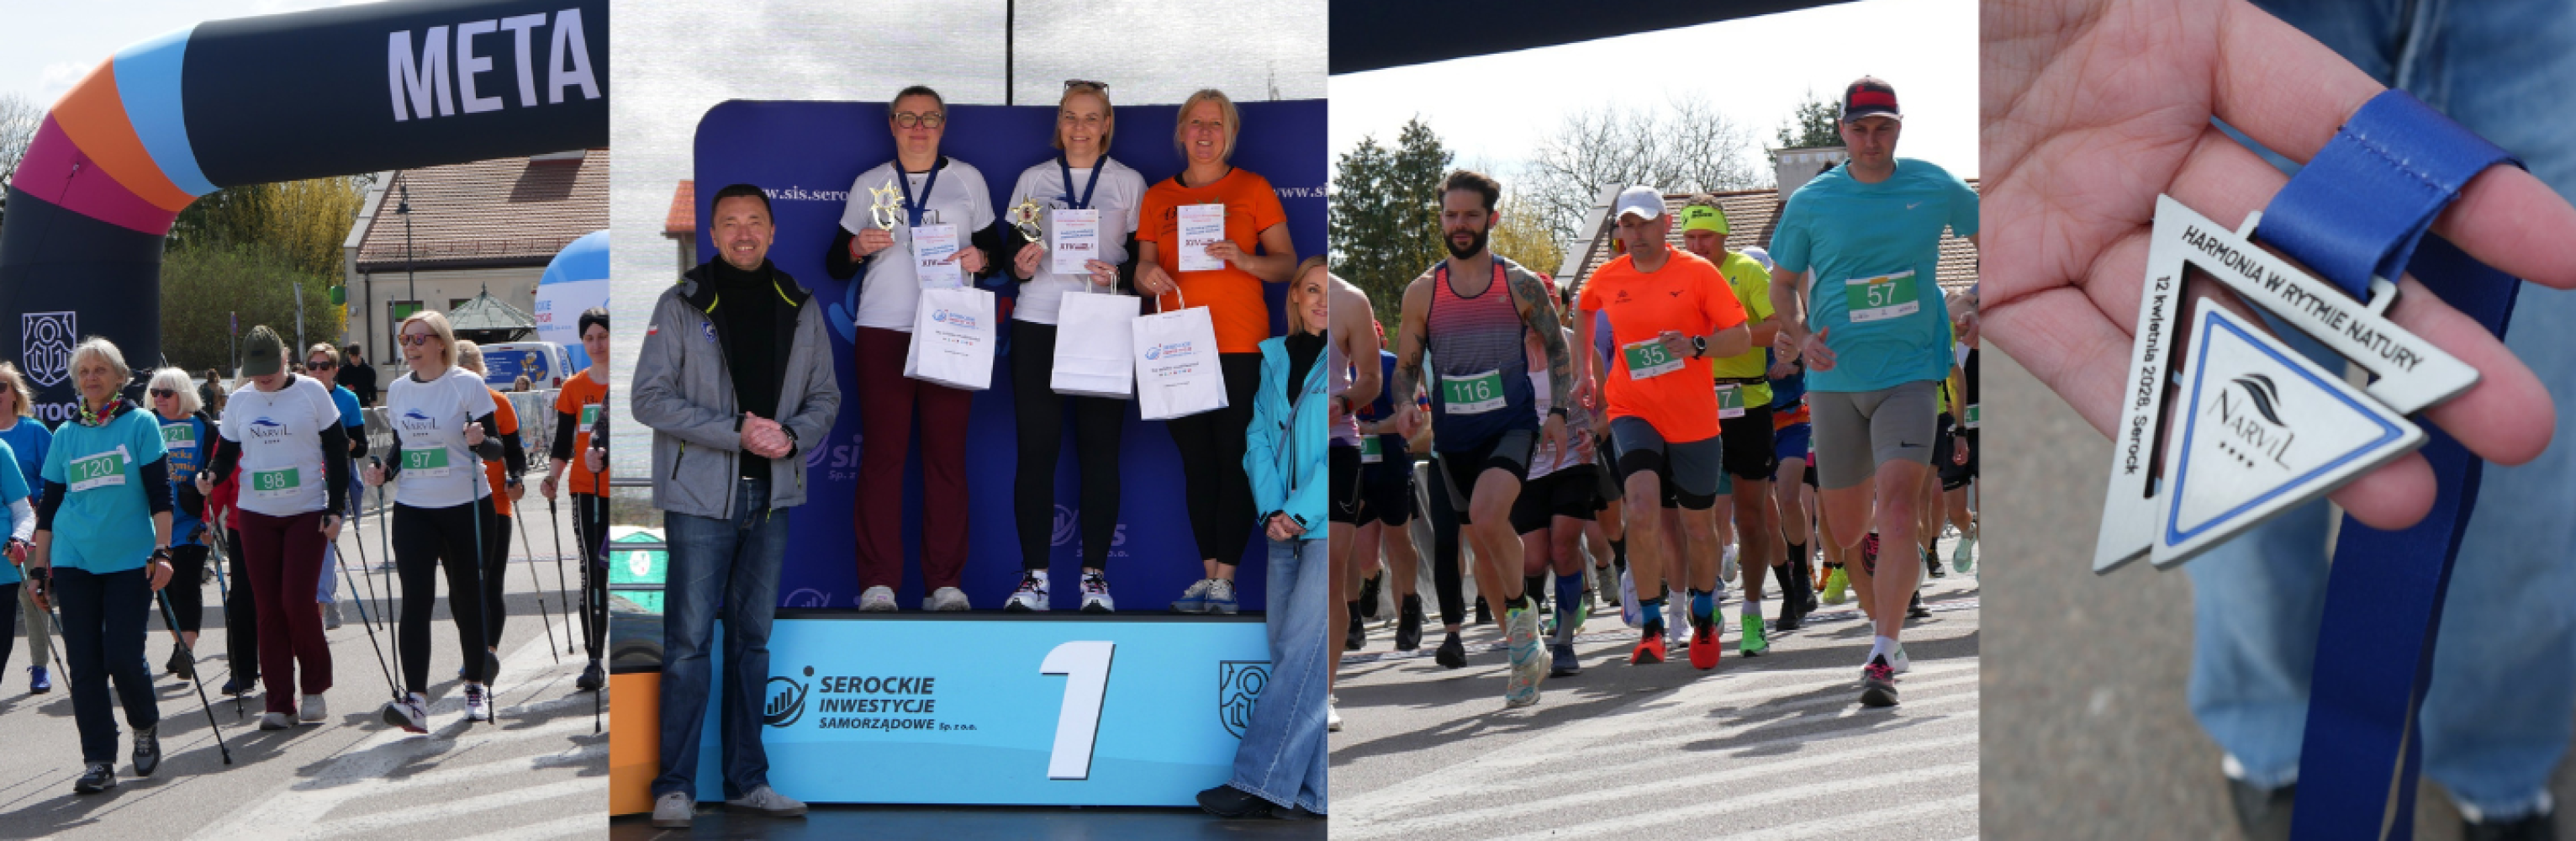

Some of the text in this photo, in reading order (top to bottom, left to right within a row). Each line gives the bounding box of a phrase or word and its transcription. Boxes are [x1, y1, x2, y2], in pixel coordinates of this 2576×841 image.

[388, 8, 601, 122] META
[2155, 275, 2171, 292] 12
[1867, 282, 1896, 307] 57
[2182, 225, 2424, 373] HARMONIA W RYTMIE NATURY
[1639, 345, 1665, 366] 35
[1453, 380, 1491, 402] 116
[163, 426, 185, 442] 121
[2125, 415, 2149, 475] Serock
[80, 458, 114, 479] 120
[410, 451, 432, 468] 97
[262, 472, 285, 489] 98
[819, 675, 936, 695] SEROCKIE
[819, 699, 936, 714] INWESTYCJE
[1039, 640, 1116, 780] 1
[819, 717, 936, 733] SAMORZĄDOWE
[938, 722, 952, 733] Sp.
